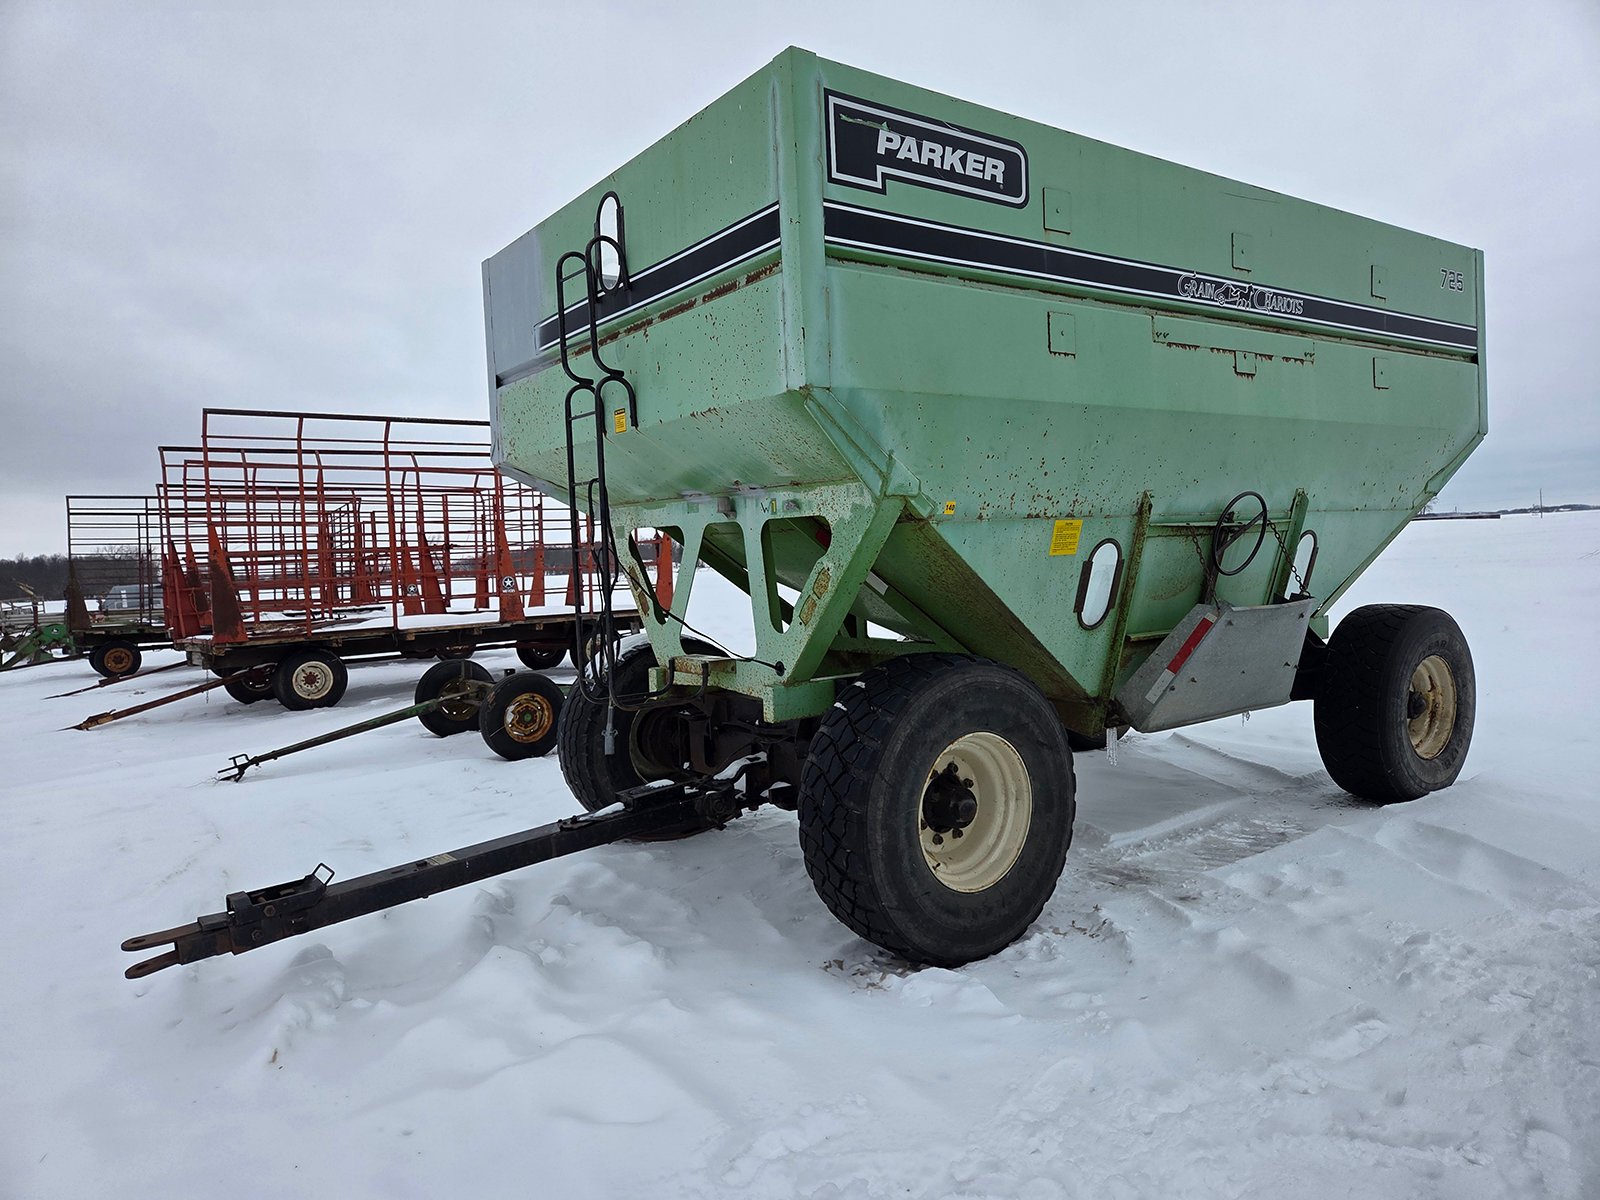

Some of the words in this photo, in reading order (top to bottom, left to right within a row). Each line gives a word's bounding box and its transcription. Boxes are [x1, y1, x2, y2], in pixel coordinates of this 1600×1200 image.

[877, 129, 1006, 184] PARKER
[1178, 272, 1216, 299] GRAIN
[1253, 287, 1304, 315] CHARIOTS
[1440, 268, 1464, 292] 725
